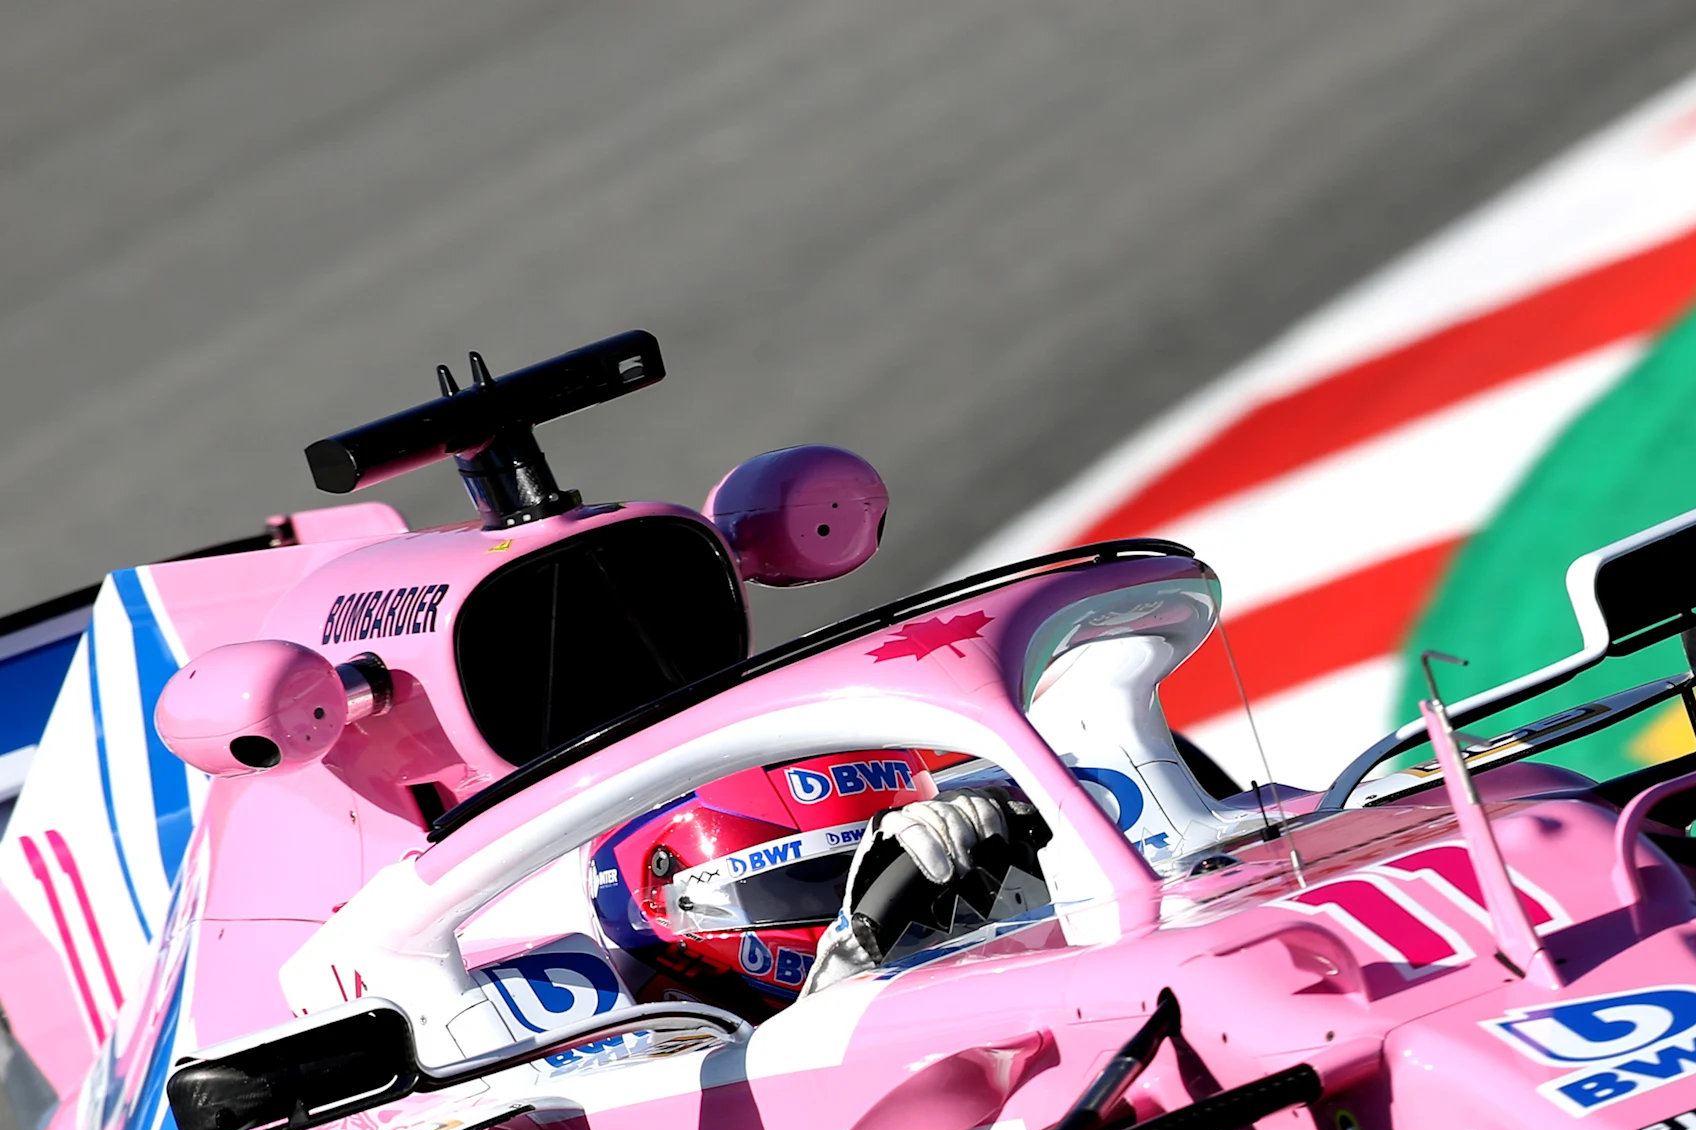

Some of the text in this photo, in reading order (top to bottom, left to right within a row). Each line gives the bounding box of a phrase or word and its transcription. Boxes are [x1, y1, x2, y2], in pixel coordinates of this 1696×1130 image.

[322, 584, 449, 645] BOMBARDIER
[829, 760, 917, 796] BWT
[842, 828, 866, 843] BW
[749, 840, 802, 872] BWT
